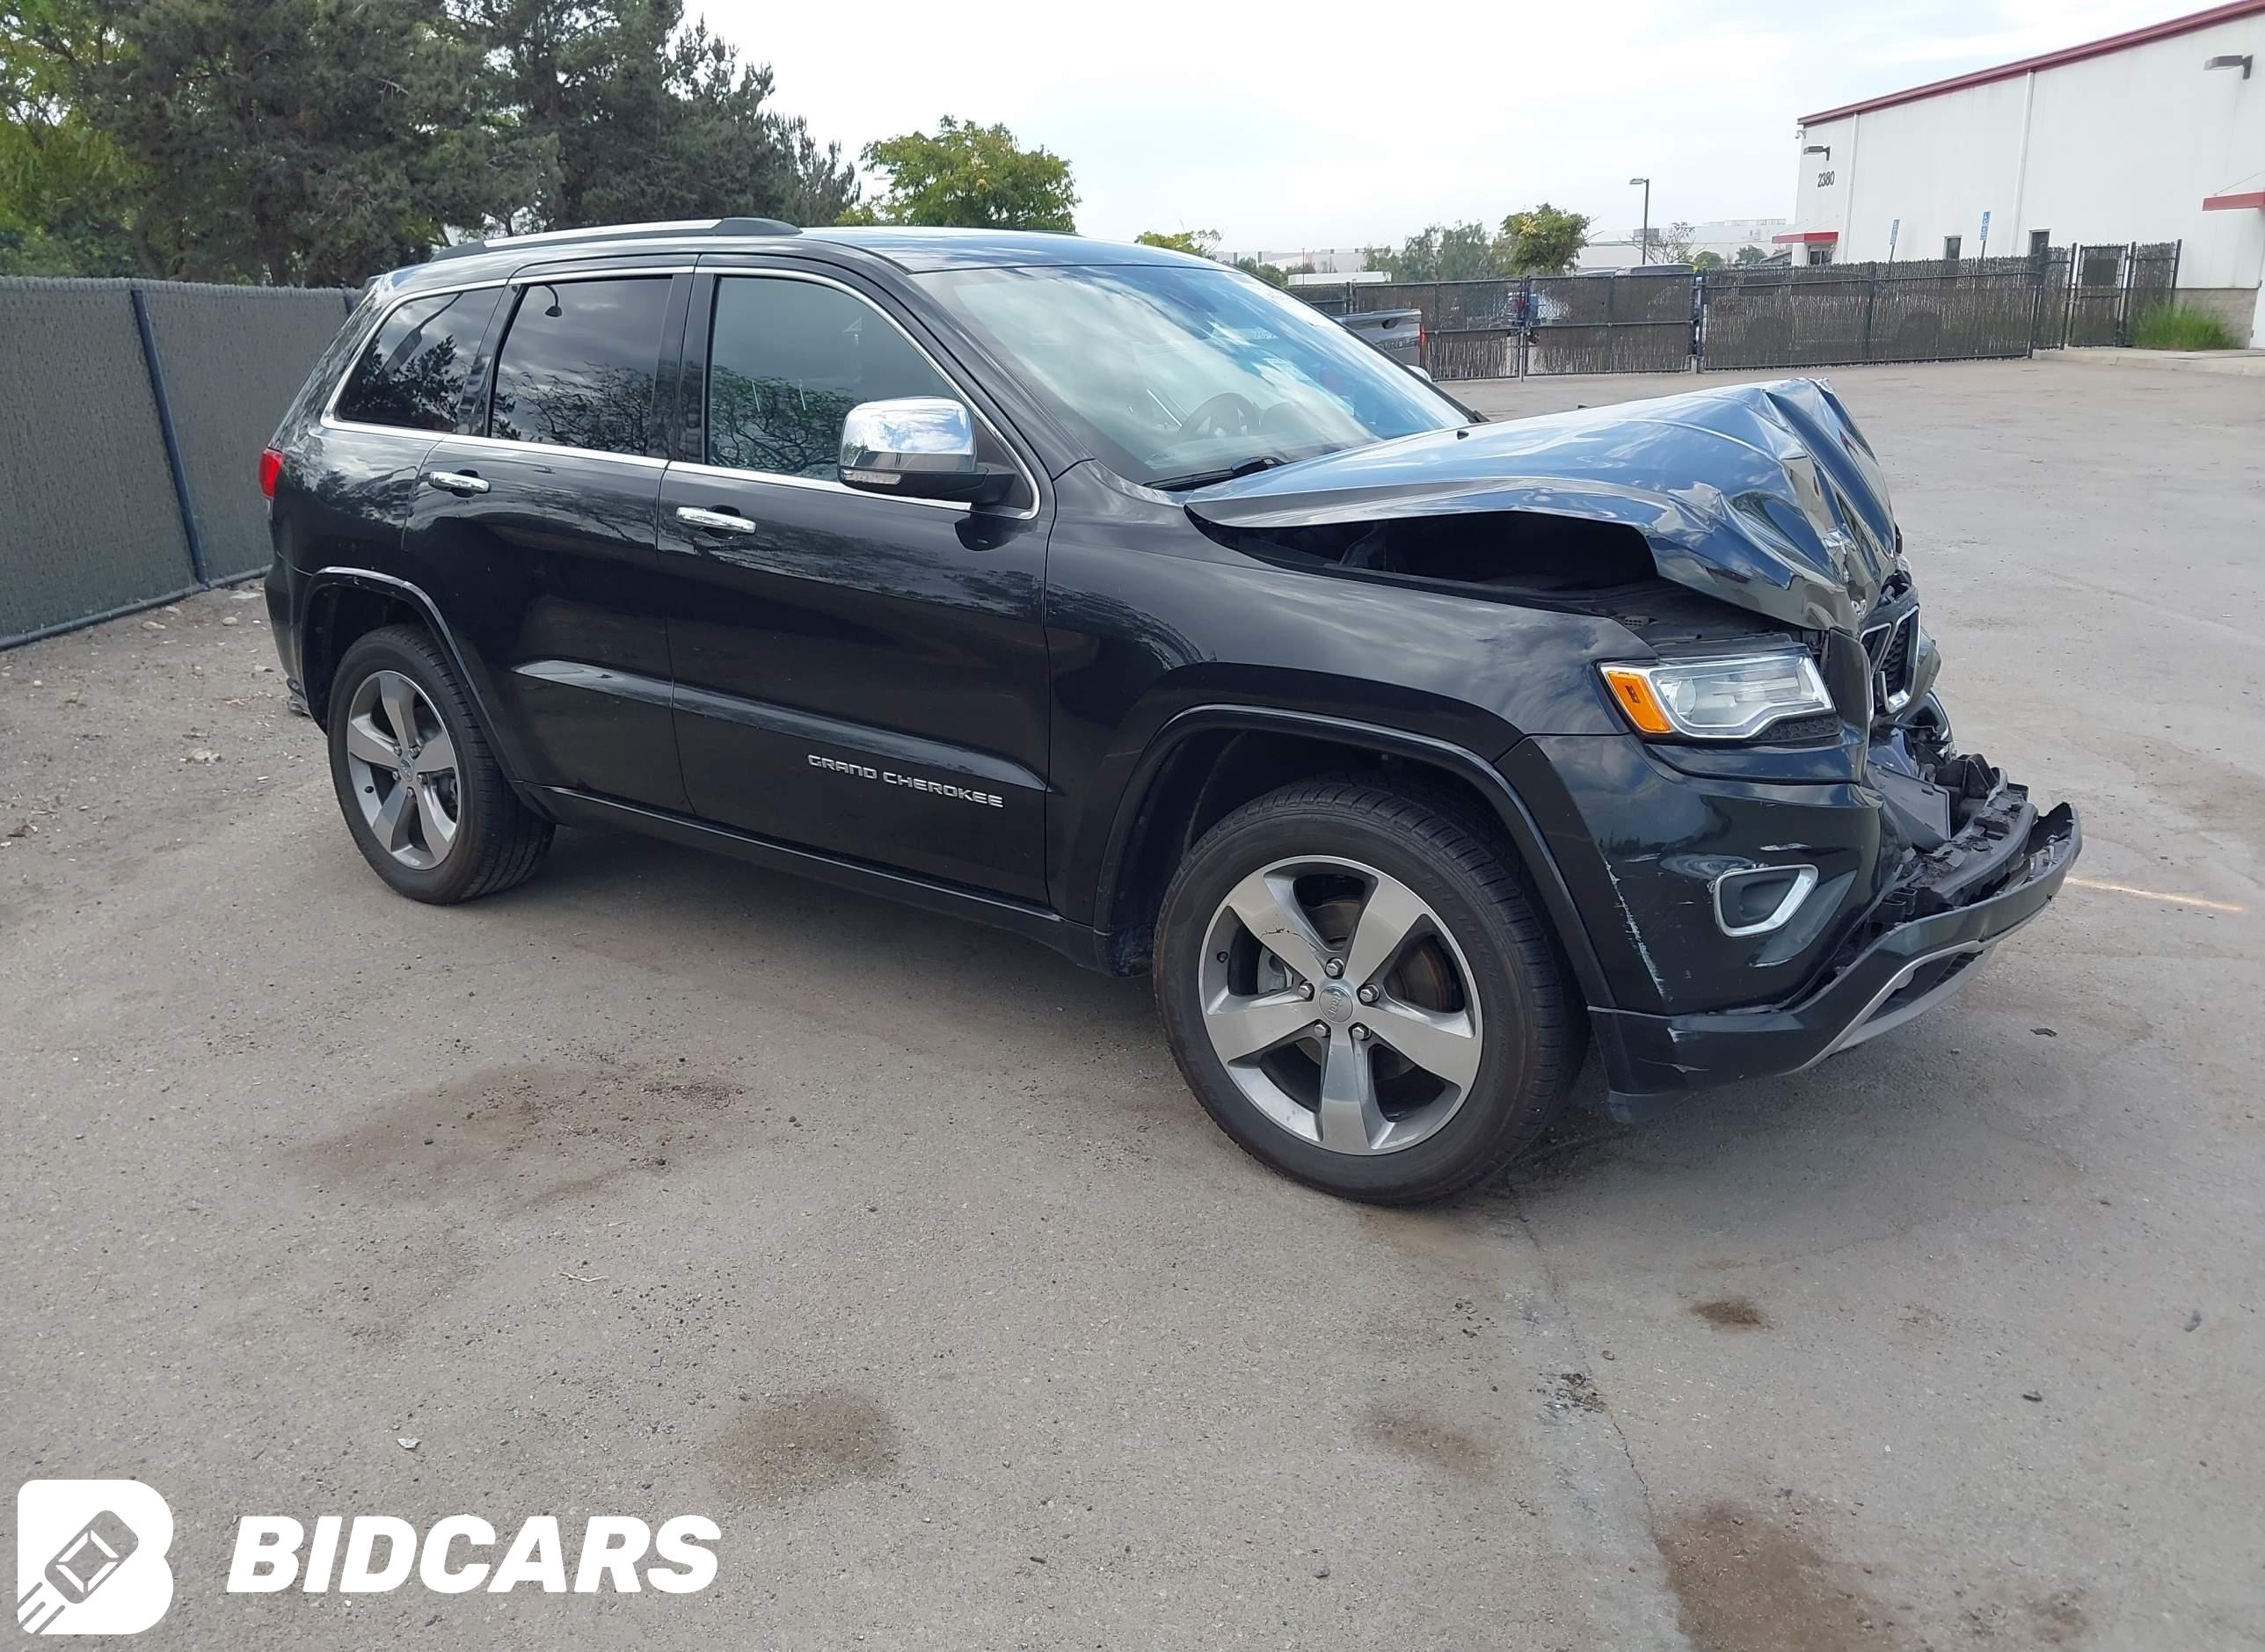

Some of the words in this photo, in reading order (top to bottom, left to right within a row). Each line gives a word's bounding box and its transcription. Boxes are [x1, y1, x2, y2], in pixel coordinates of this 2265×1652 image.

[1817, 171, 1835, 187] 2380
[808, 754, 878, 780] GRAND
[883, 771, 1004, 808] CHEROKEE
